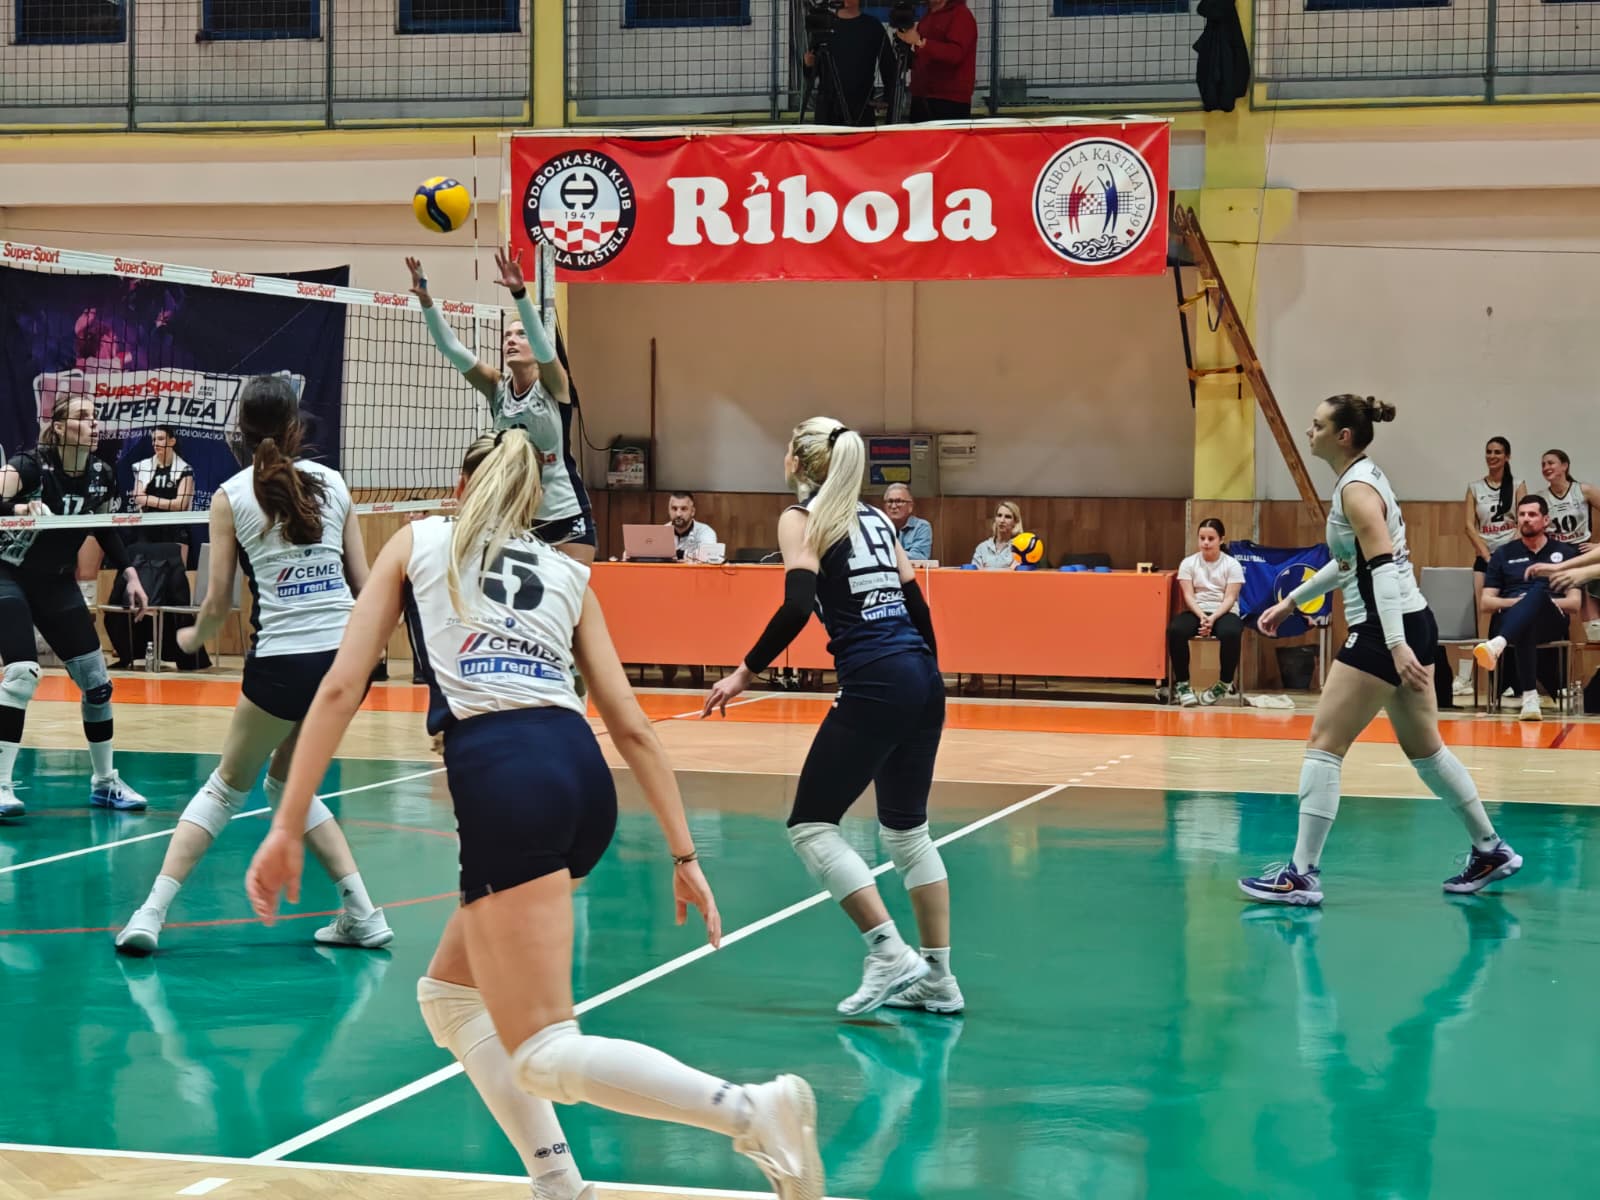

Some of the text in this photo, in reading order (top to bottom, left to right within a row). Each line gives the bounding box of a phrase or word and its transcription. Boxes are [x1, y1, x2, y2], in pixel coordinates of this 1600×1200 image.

[528, 153, 632, 210] ODBOJKAŠKI KLUB
[1045, 151, 1089, 195] RIBOLA
[1129, 196, 1147, 227] 1949
[564, 211, 596, 220] 1947
[667, 172, 997, 246] Ribola
[3, 242, 60, 264] SuperSport
[530, 225, 572, 265] RIBLA
[113, 257, 164, 277] SuperSport
[210, 270, 256, 289] SuperSport
[297, 282, 337, 299] SuperSport
[373, 291, 409, 307] SuperSport
[442, 300, 474, 315] SuperSport
[95, 377, 194, 399] SuperSport
[165, 396, 217, 420] LIGA
[155, 474, 167, 488] 11
[62, 494, 85, 515] 17
[1490, 504, 1505, 522] 2
[1551, 514, 1578, 535] 10
[848, 514, 898, 570] 15
[279, 581, 328, 597] uni rent
[478, 547, 545, 611] 5
[464, 659, 496, 675] uni
[501, 661, 540, 676] rent
